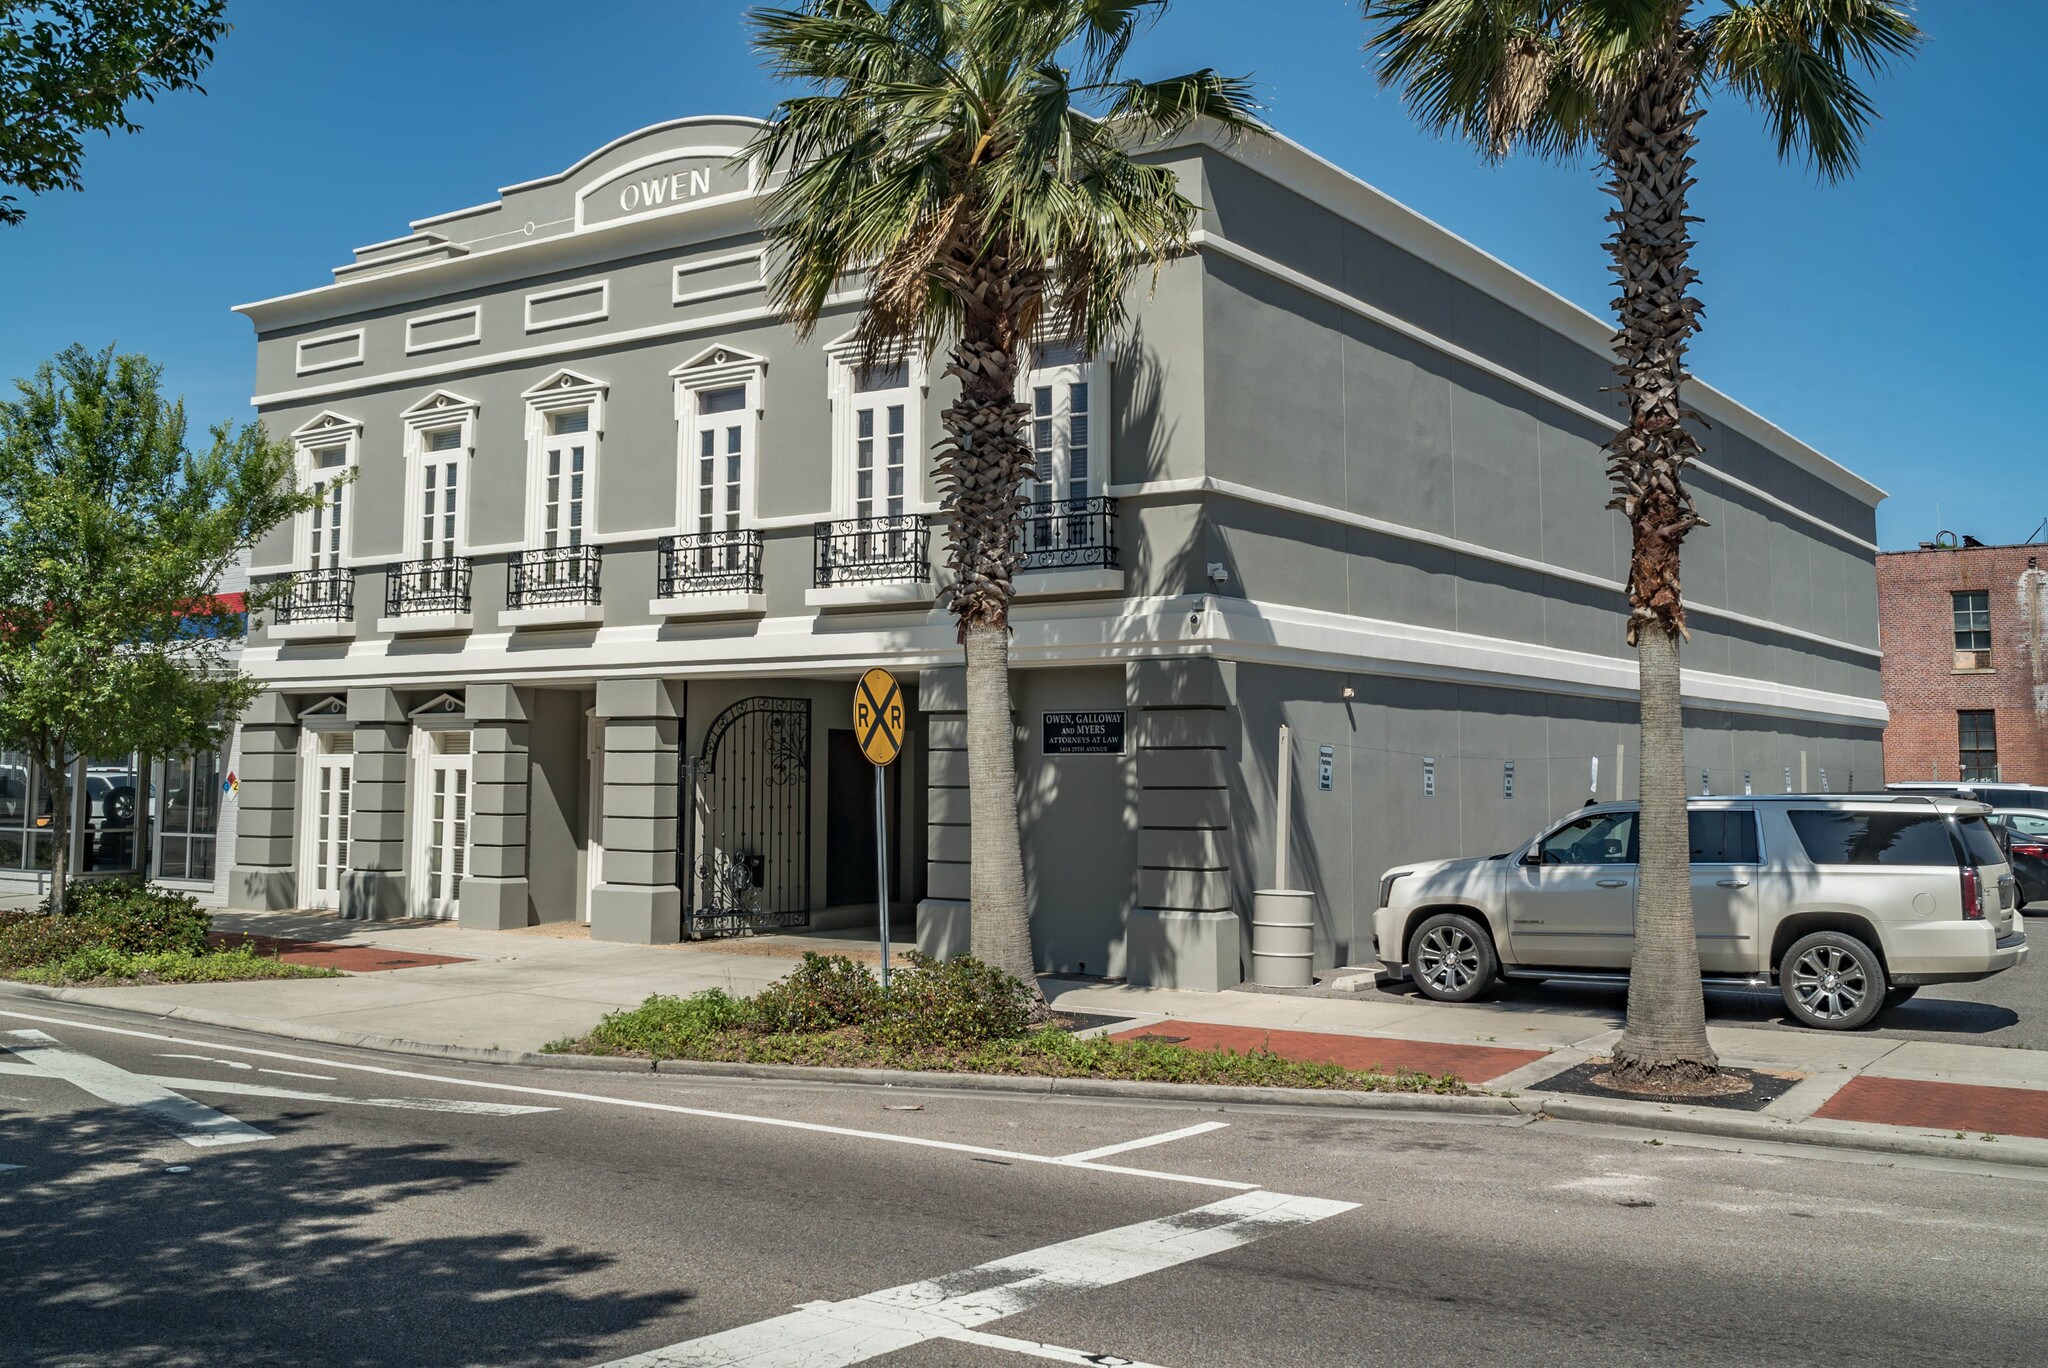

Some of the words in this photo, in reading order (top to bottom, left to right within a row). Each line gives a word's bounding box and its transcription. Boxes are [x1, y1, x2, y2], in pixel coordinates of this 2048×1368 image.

[620, 165, 710, 211] OWEN
[858, 703, 868, 727] R
[891, 706, 901, 729] R
[1046, 714, 1074, 725] OWEN,
[1076, 714, 1121, 724] GALLOWAY
[1076, 725, 1105, 734] MYERS
